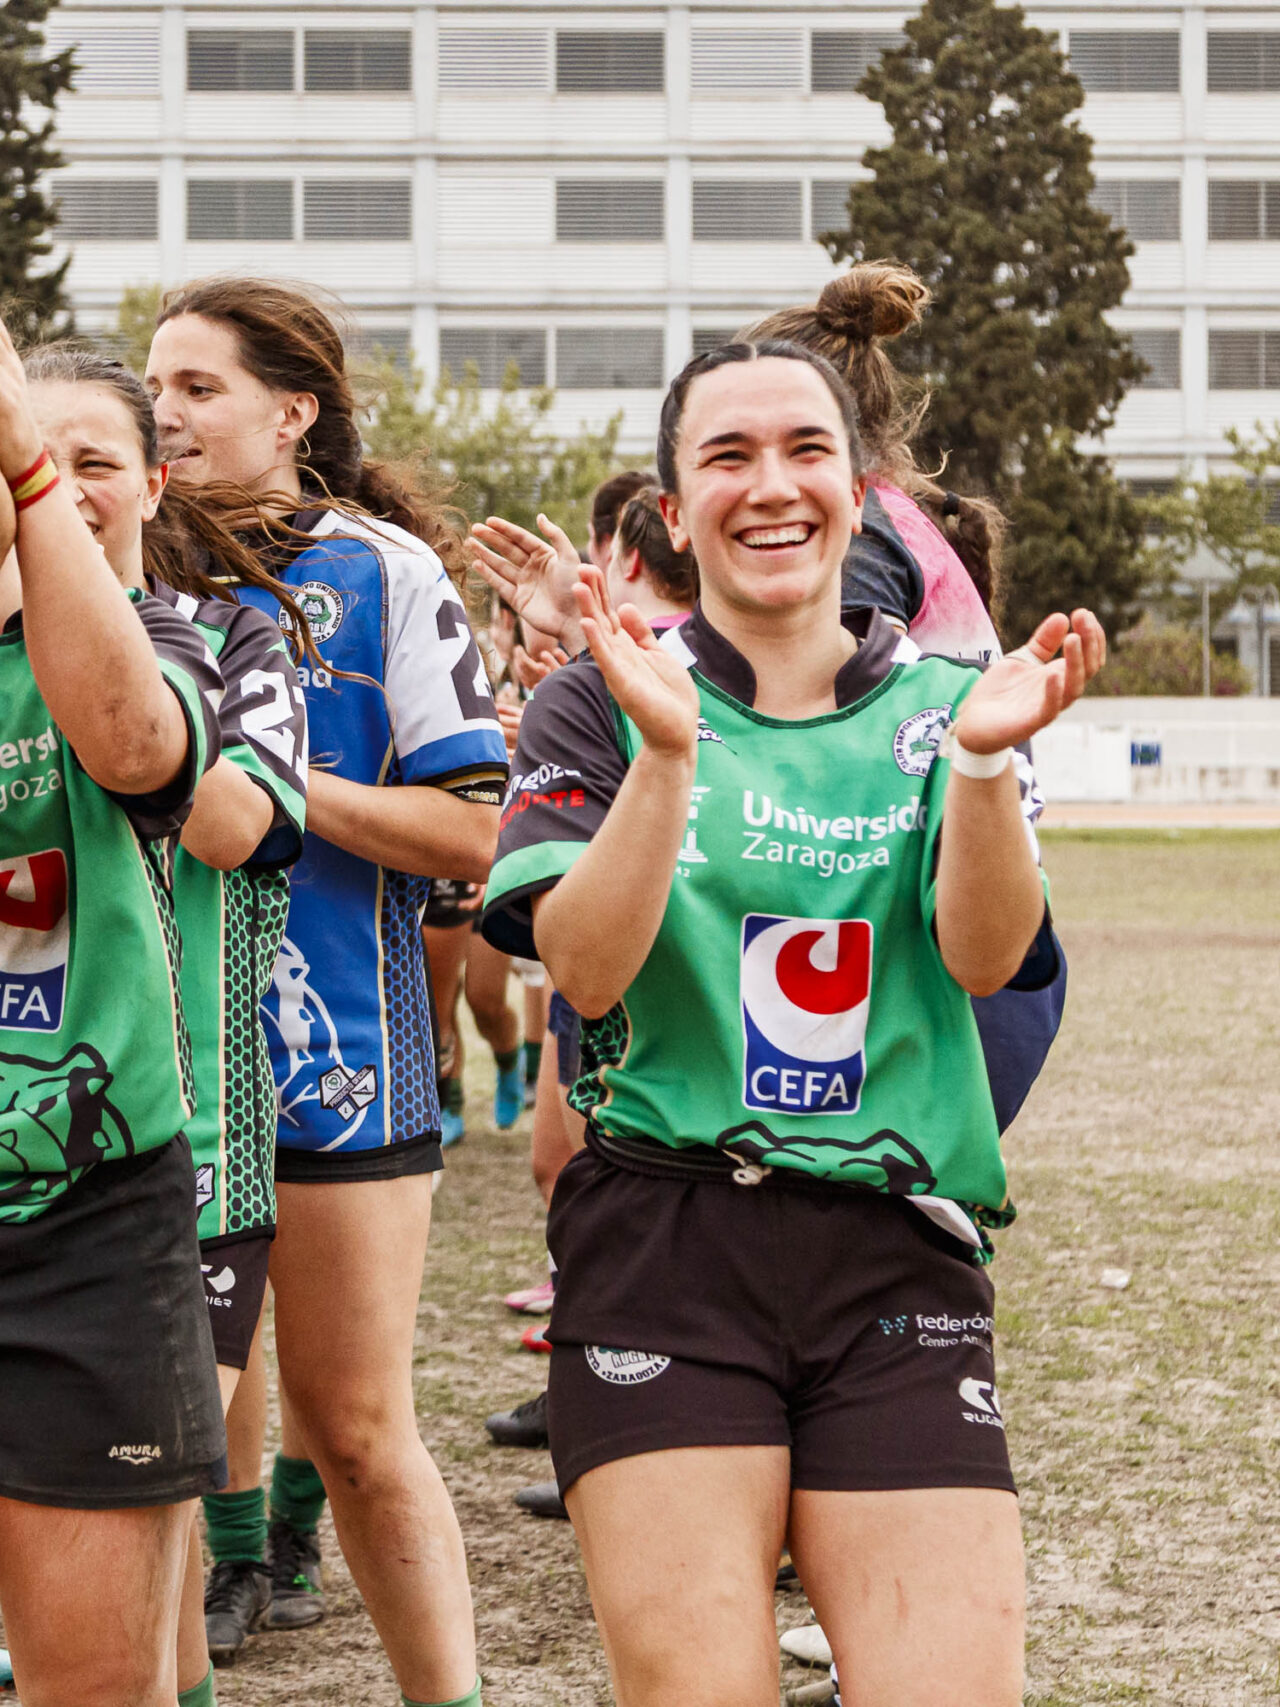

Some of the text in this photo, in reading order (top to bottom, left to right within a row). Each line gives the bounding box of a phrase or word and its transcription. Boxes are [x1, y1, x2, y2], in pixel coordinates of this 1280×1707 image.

[740, 830, 890, 878] Zaragoza
[750, 1064, 850, 1106] CEFA
[918, 1333, 959, 1348] Centro
[605, 1362, 664, 1382] ZARAGOZA
[108, 1445, 163, 1459] AMURA
